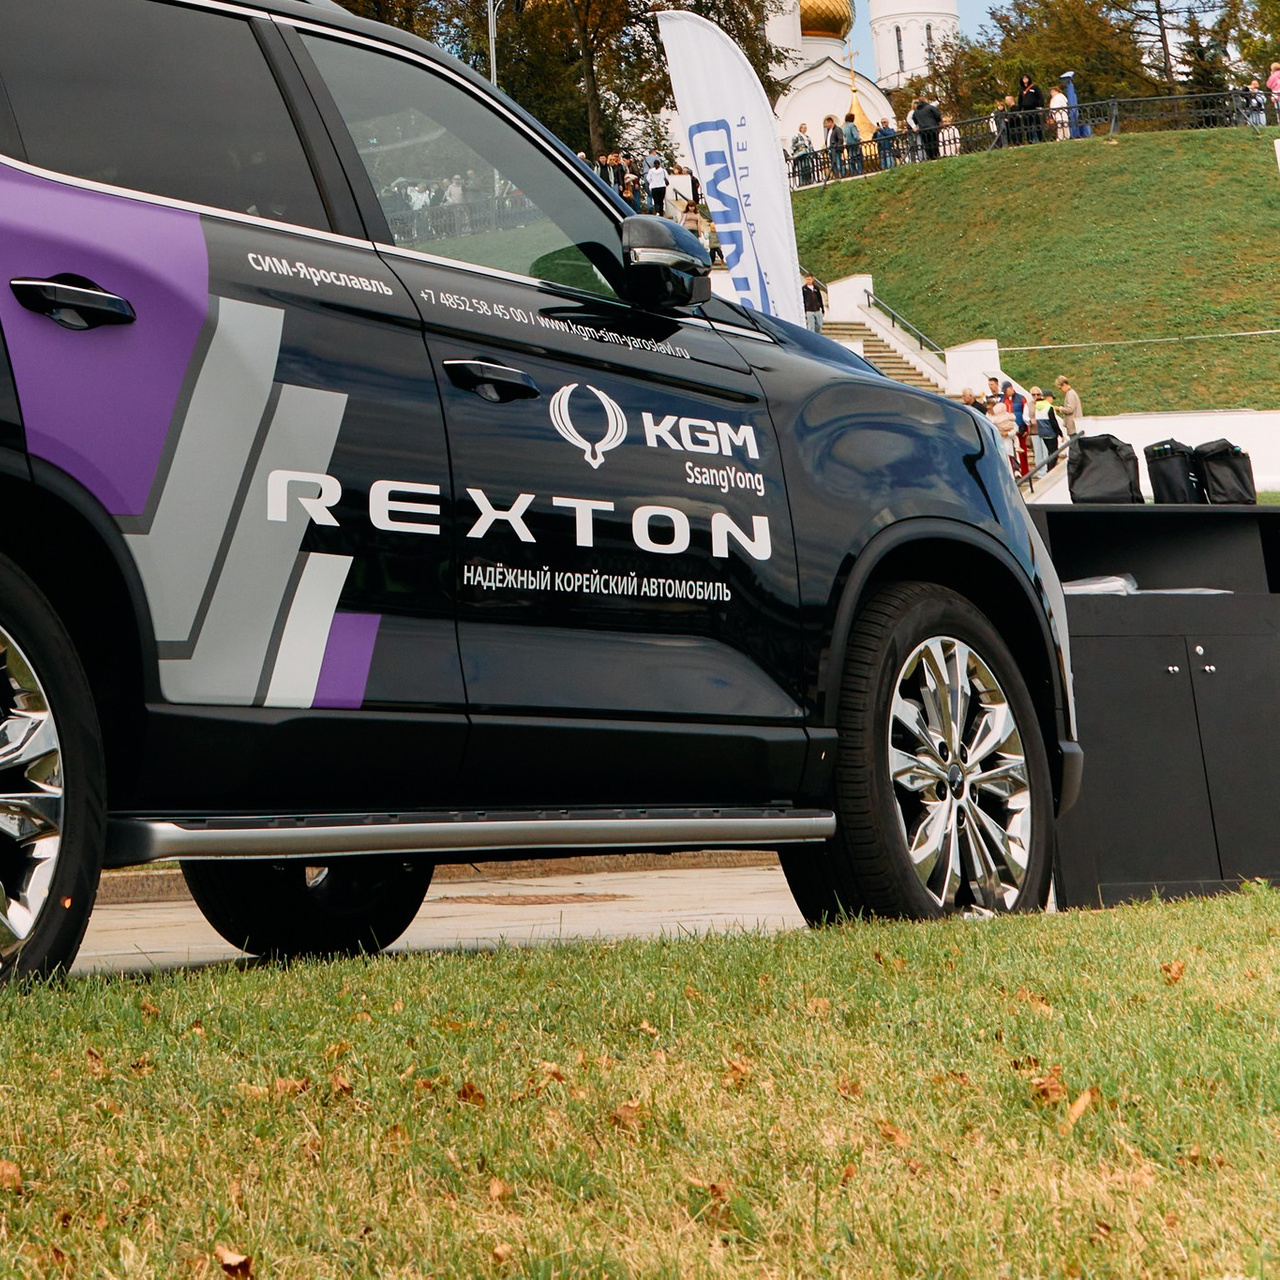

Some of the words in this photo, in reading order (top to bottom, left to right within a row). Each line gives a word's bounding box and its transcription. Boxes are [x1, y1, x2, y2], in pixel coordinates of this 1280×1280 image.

[247, 252, 394, 297] СИМ-Ярославль
[420, 289, 436, 304] +7
[440, 292, 473, 312] 4852
[472, 299, 492, 316] 58
[493, 303, 511, 320] 45
[509, 307, 528, 324] 00
[536, 315, 691, 359] www.kgm-sim-yaroslavl.ru
[641, 411, 760, 459] KGM
[685, 461, 765, 496] SsangYong
[267, 469, 773, 561] REXTON
[463, 563, 551, 591] НАДЁЖНЫЙ
[554, 566, 638, 596] КОРЕЙСКИЙ
[640, 577, 732, 602] АВТОМОБИЛЬ
